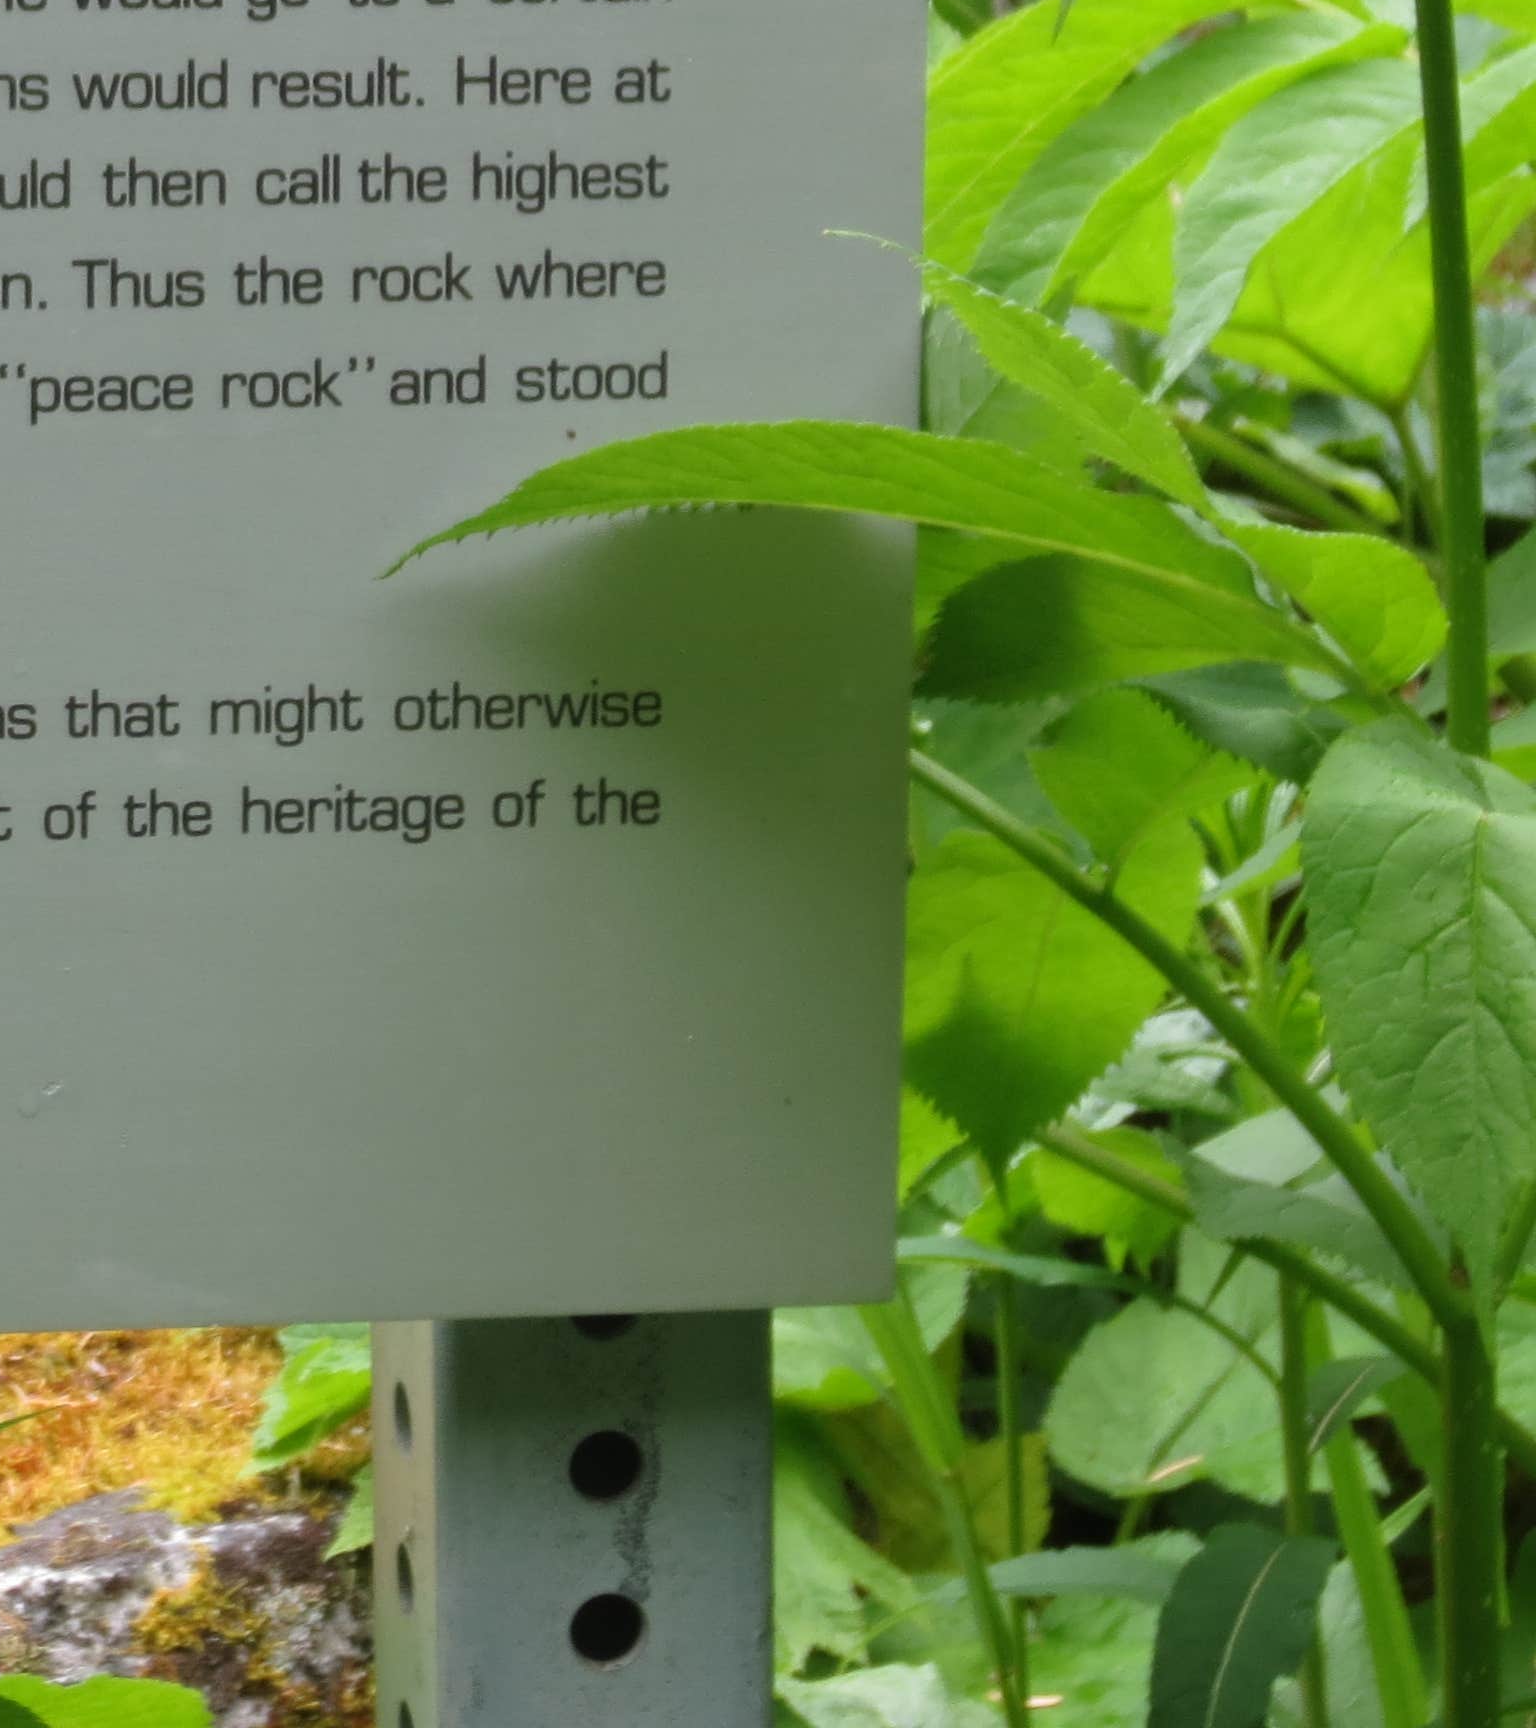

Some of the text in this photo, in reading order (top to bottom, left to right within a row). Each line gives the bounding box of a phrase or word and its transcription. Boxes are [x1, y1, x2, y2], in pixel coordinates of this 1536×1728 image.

[71, 58, 229, 111] would
[251, 55, 425, 109] result.
[455, 54, 592, 106] Here
[614, 58, 672, 105] at
[71, 257, 206, 310] Thus
[232, 254, 324, 307] the
[352, 251, 474, 303] rock
[494, 247, 667, 301] where
[221, 355, 376, 409] rock”
[389, 353, 487, 407] and
[515, 349, 669, 407] stood
[63, 688, 181, 739] that
[209, 683, 364, 748] might
[393, 679, 663, 732] otherwise
[43, 789, 97, 841] of
[122, 787, 213, 838] the
[241, 783, 465, 845] heritage
[492, 778, 546, 829] of
[572, 776, 661, 827] the
